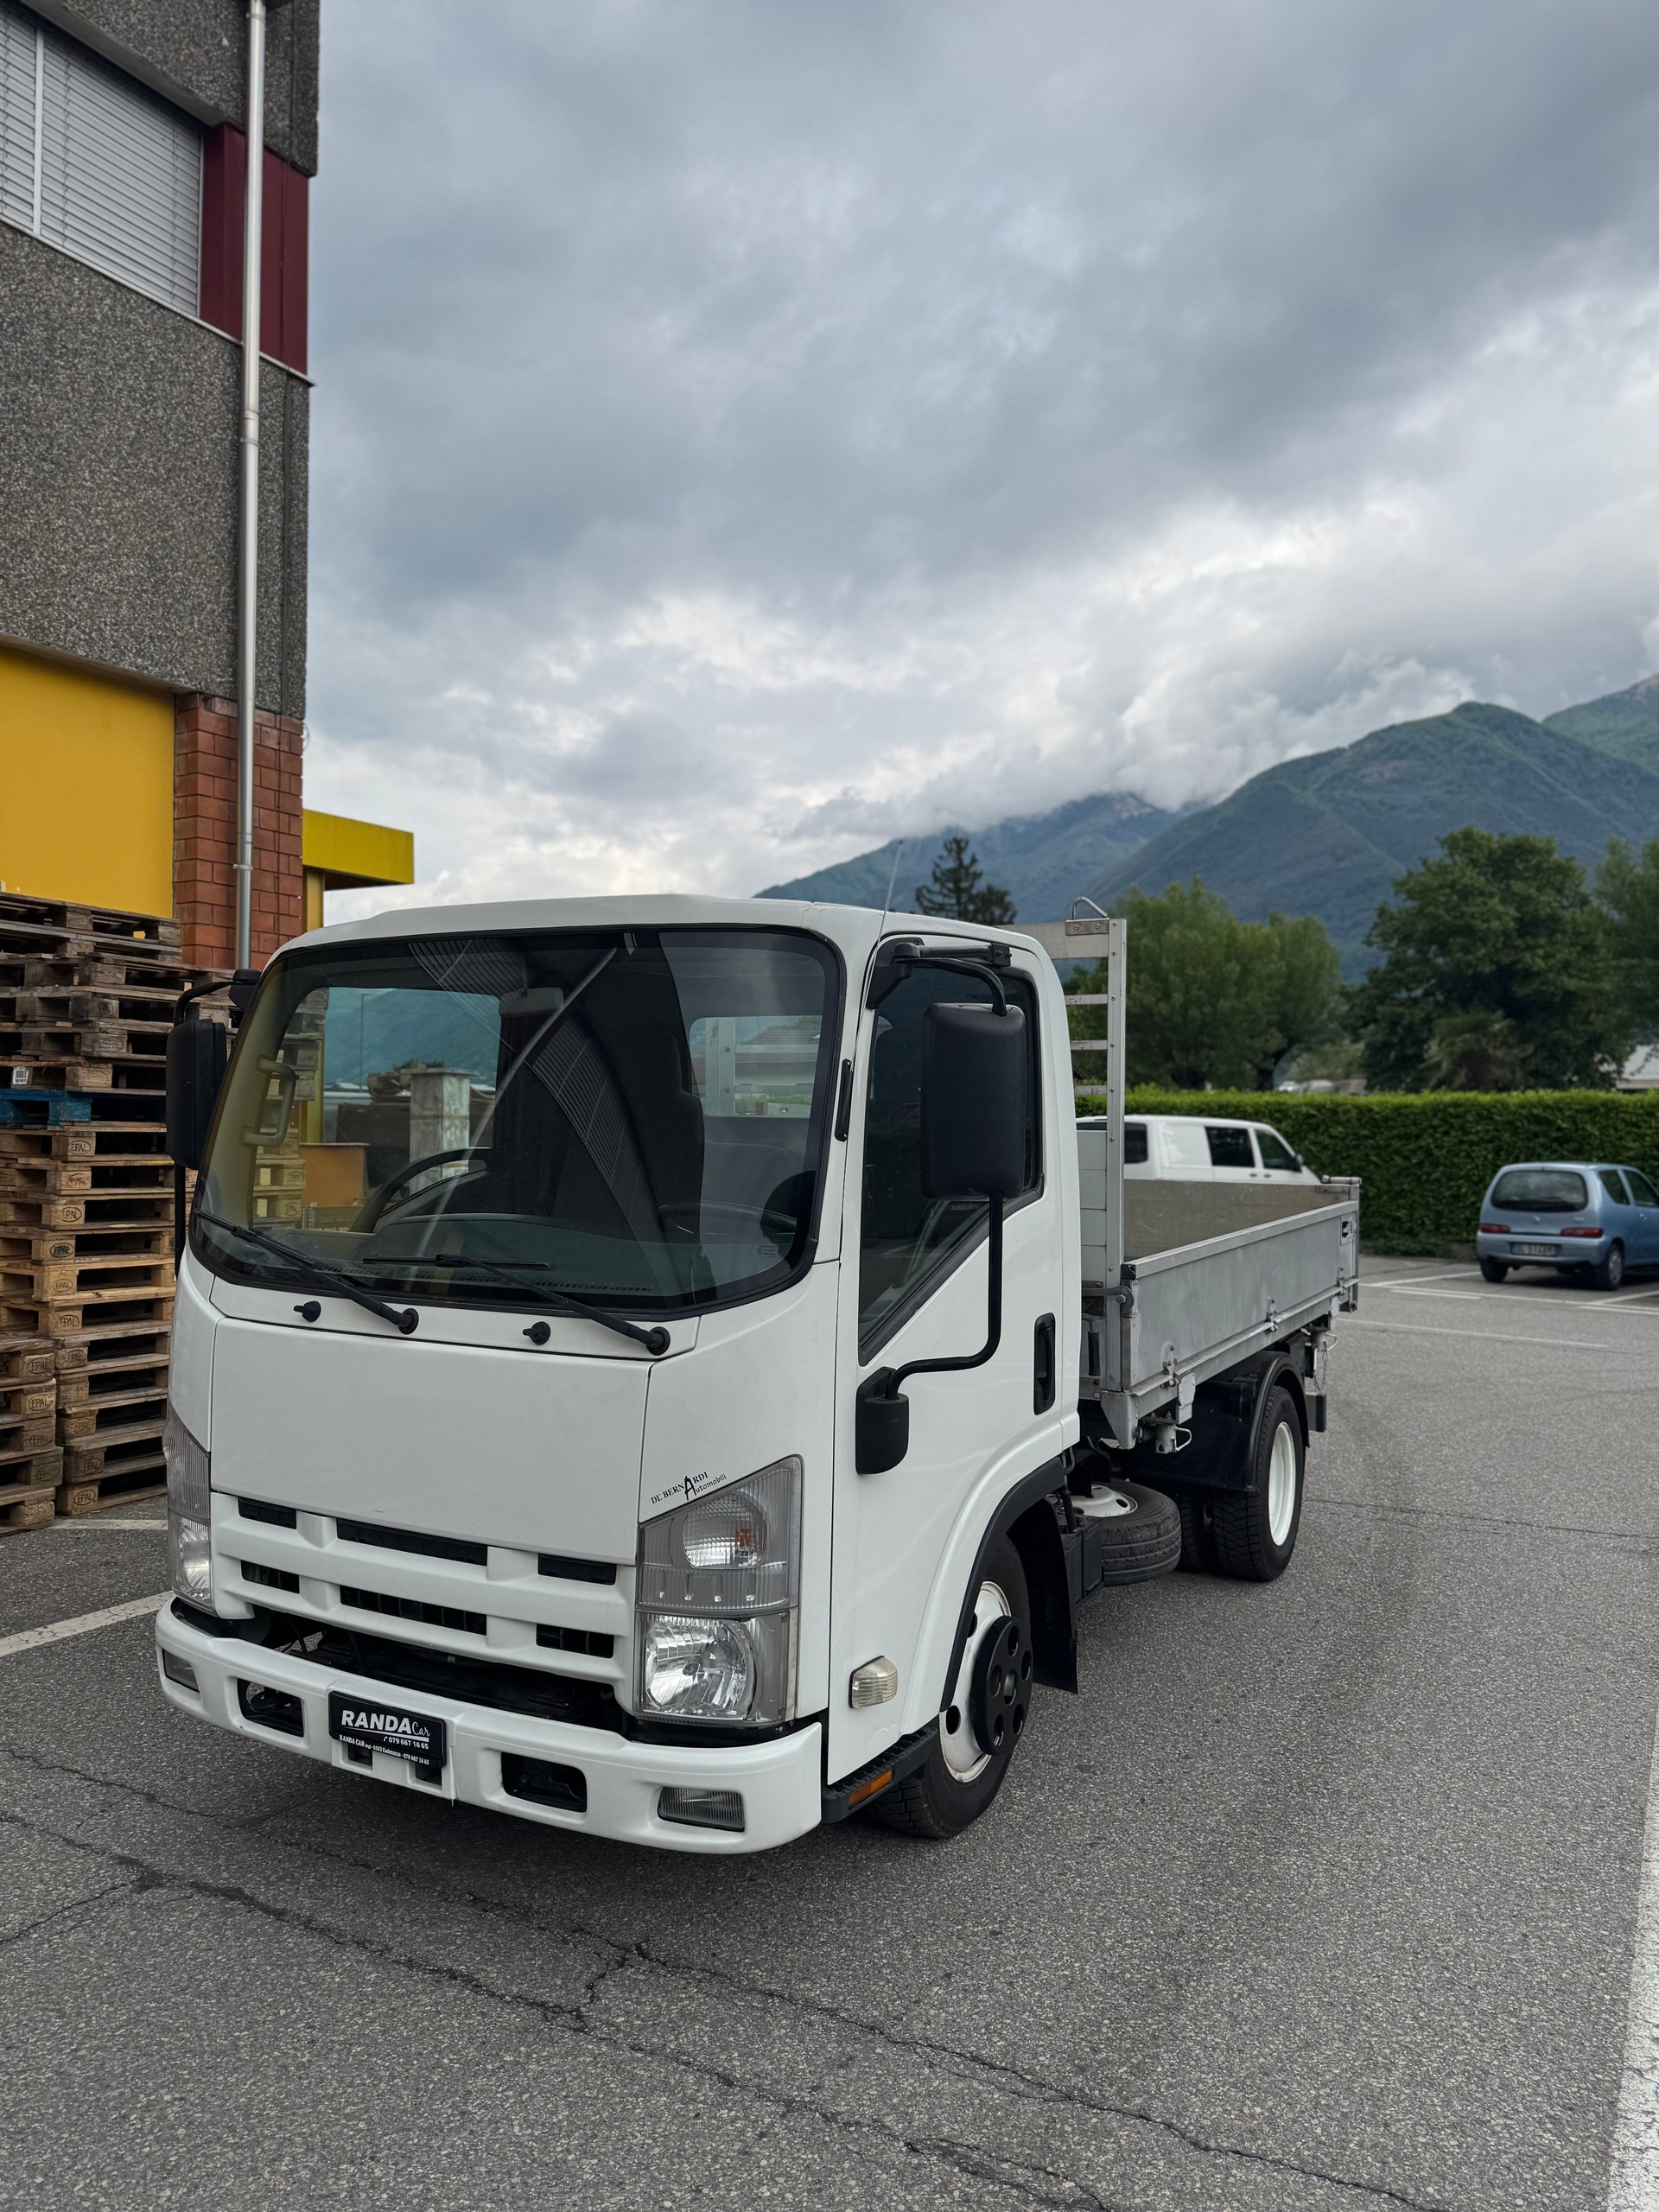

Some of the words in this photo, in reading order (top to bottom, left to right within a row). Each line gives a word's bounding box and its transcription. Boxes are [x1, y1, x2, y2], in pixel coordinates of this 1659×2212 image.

[71, 1143, 87, 1152] EPAL
[54, 1245, 71, 1255] EPAL
[55, 1281, 71, 1290] EPAL
[31, 1359, 49, 1371] EPAL
[31, 1397, 49, 1408] EPAL
[77, 1492, 92, 1503] EPAL
[341, 1710, 412, 1734] RANDA
[411, 1721, 431, 1737] Car
